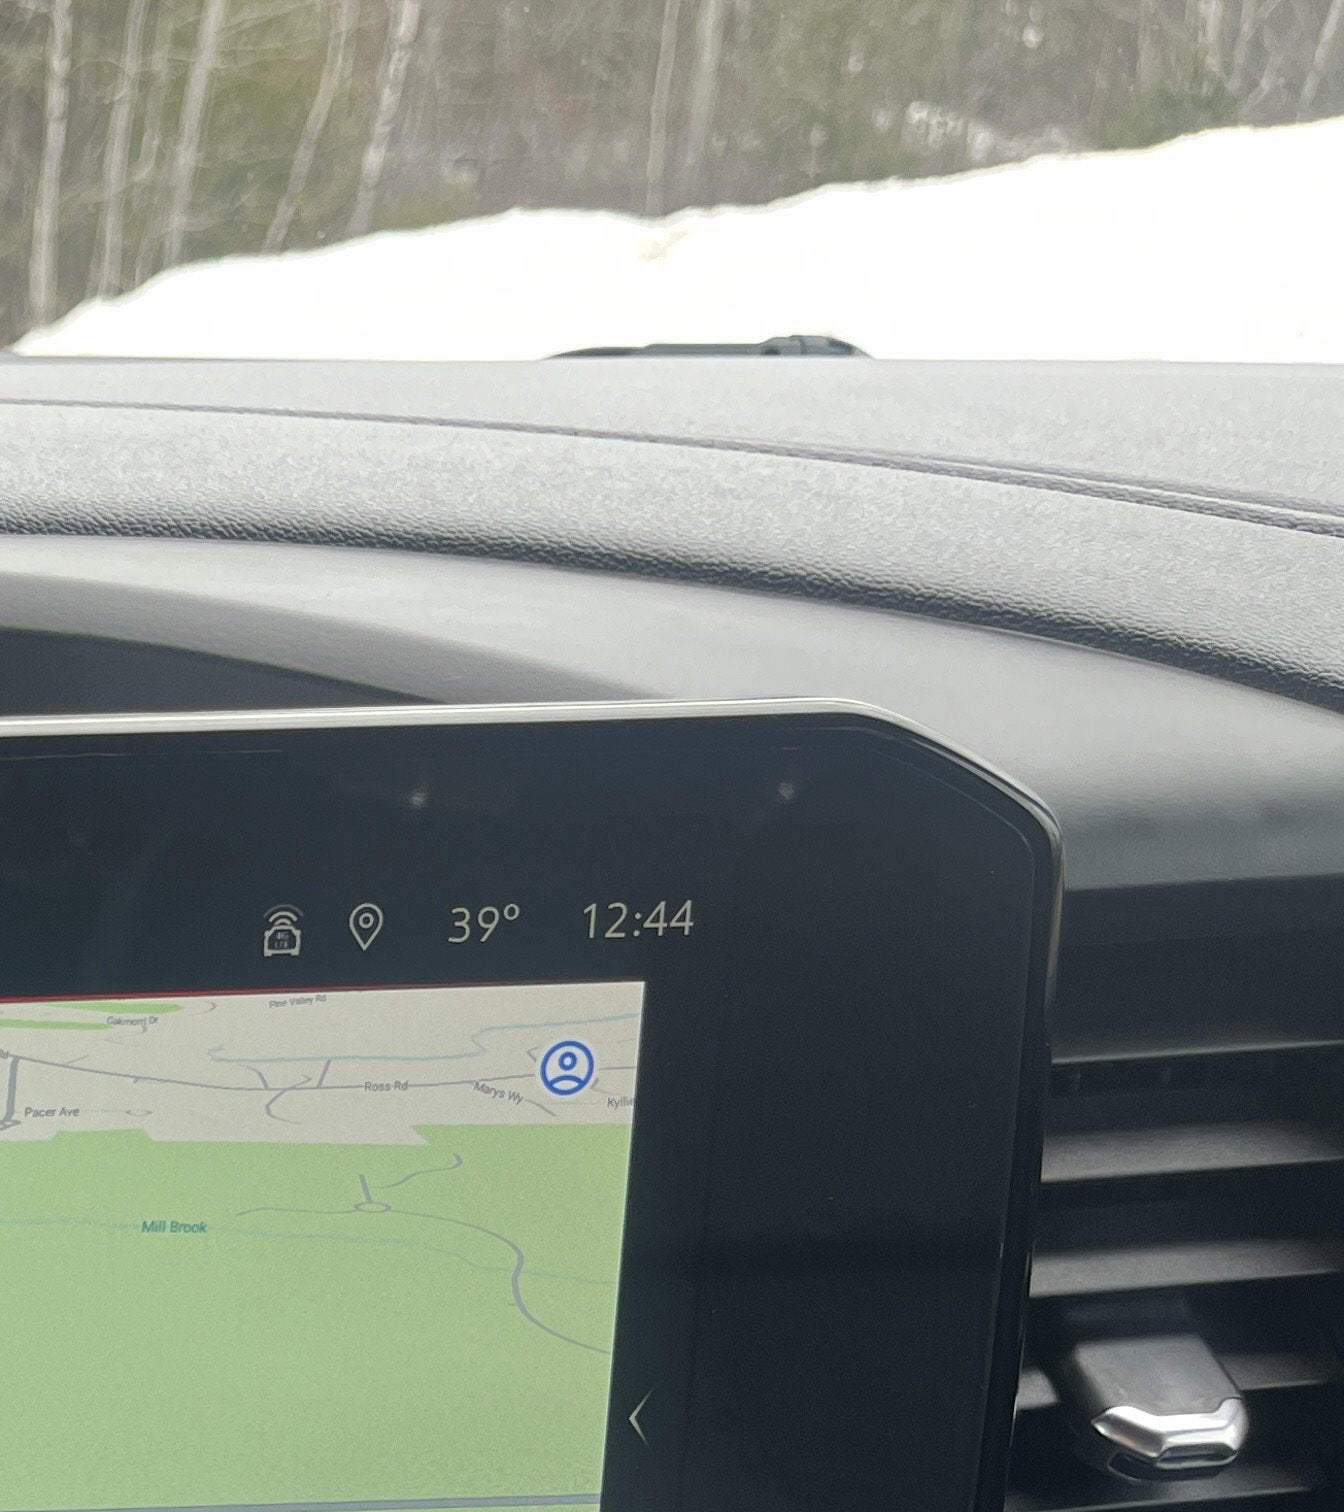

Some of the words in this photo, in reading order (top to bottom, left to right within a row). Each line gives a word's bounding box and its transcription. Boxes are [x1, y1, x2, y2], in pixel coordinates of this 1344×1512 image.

[448, 903, 520, 944] 39°
[583, 900, 695, 940] 12:44
[364, 1081, 392, 1092] Ross
[394, 1080, 408, 1091] Rd
[474, 1081, 505, 1100] Marys
[504, 1089, 523, 1105] Wy
[24, 1106, 56, 1118] Pacer
[59, 1106, 80, 1117] Ave
[142, 1220, 166, 1233] Mill
[170, 1220, 208, 1234] Brook
